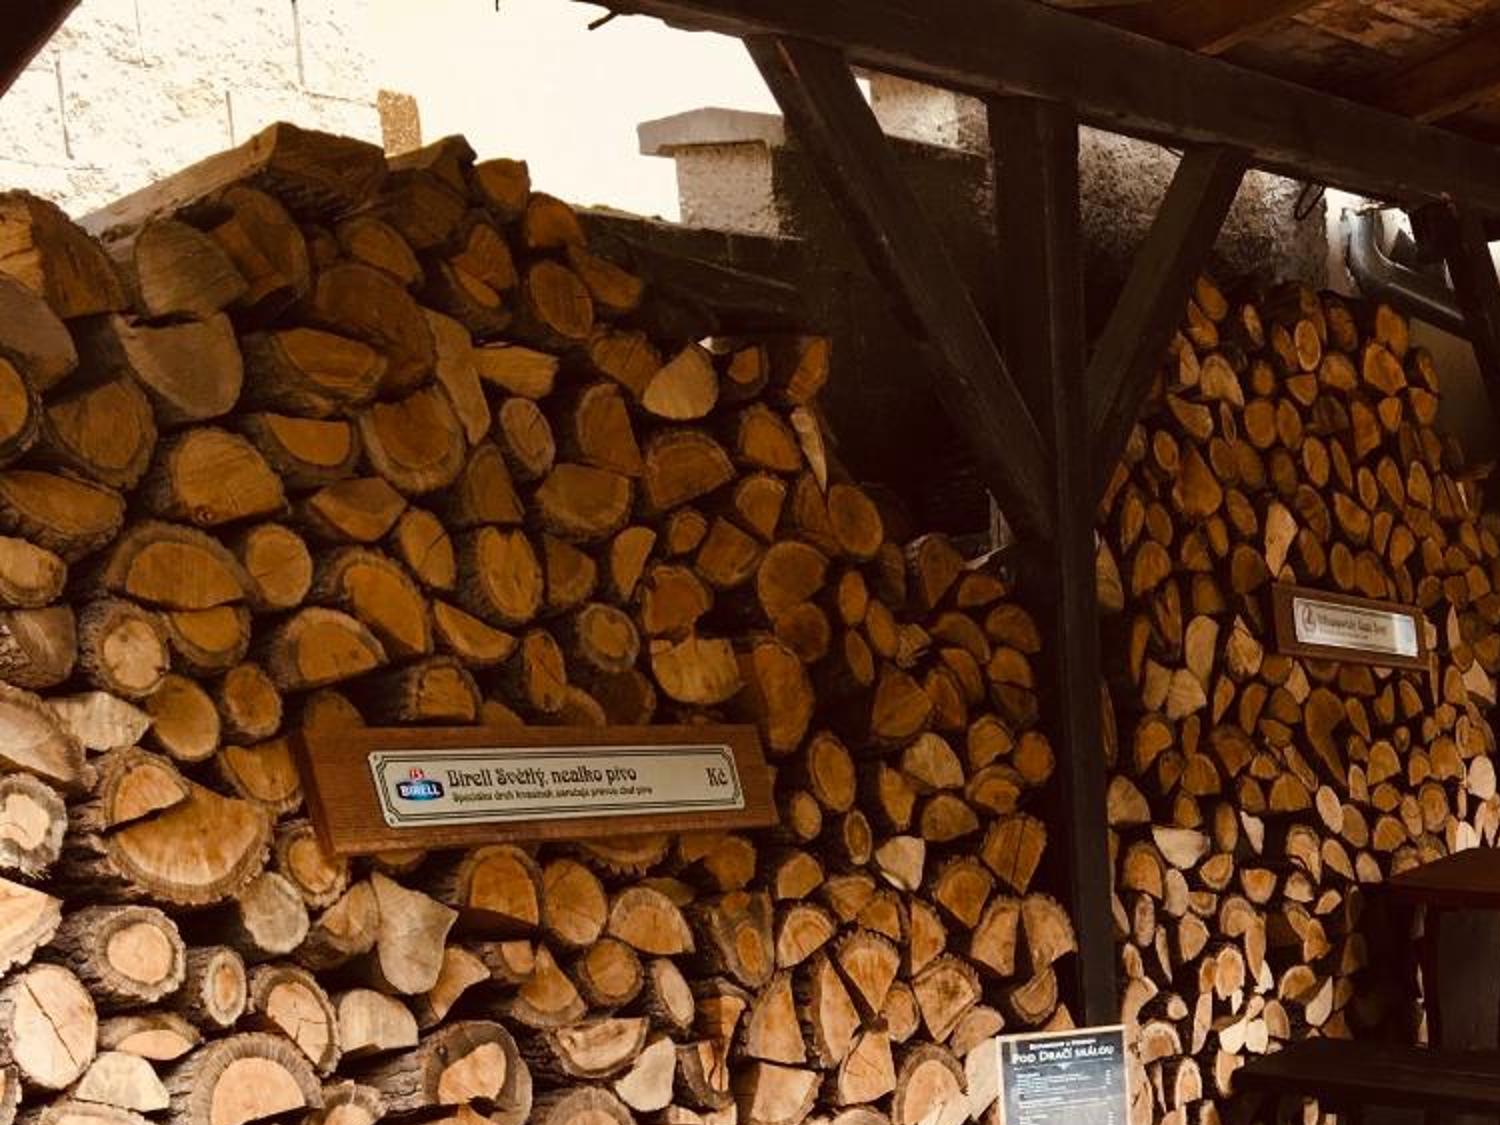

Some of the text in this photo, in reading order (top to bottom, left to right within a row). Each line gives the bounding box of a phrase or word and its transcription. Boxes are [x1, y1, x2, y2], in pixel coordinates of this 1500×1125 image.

[447, 768, 493, 787] Birell
[551, 765, 602, 784] nealko
[606, 766, 637, 785] pivo
[706, 767, 729, 786] Kč
[400, 785, 441, 797] BIRELL
[1012, 1053, 1037, 1065] POD
